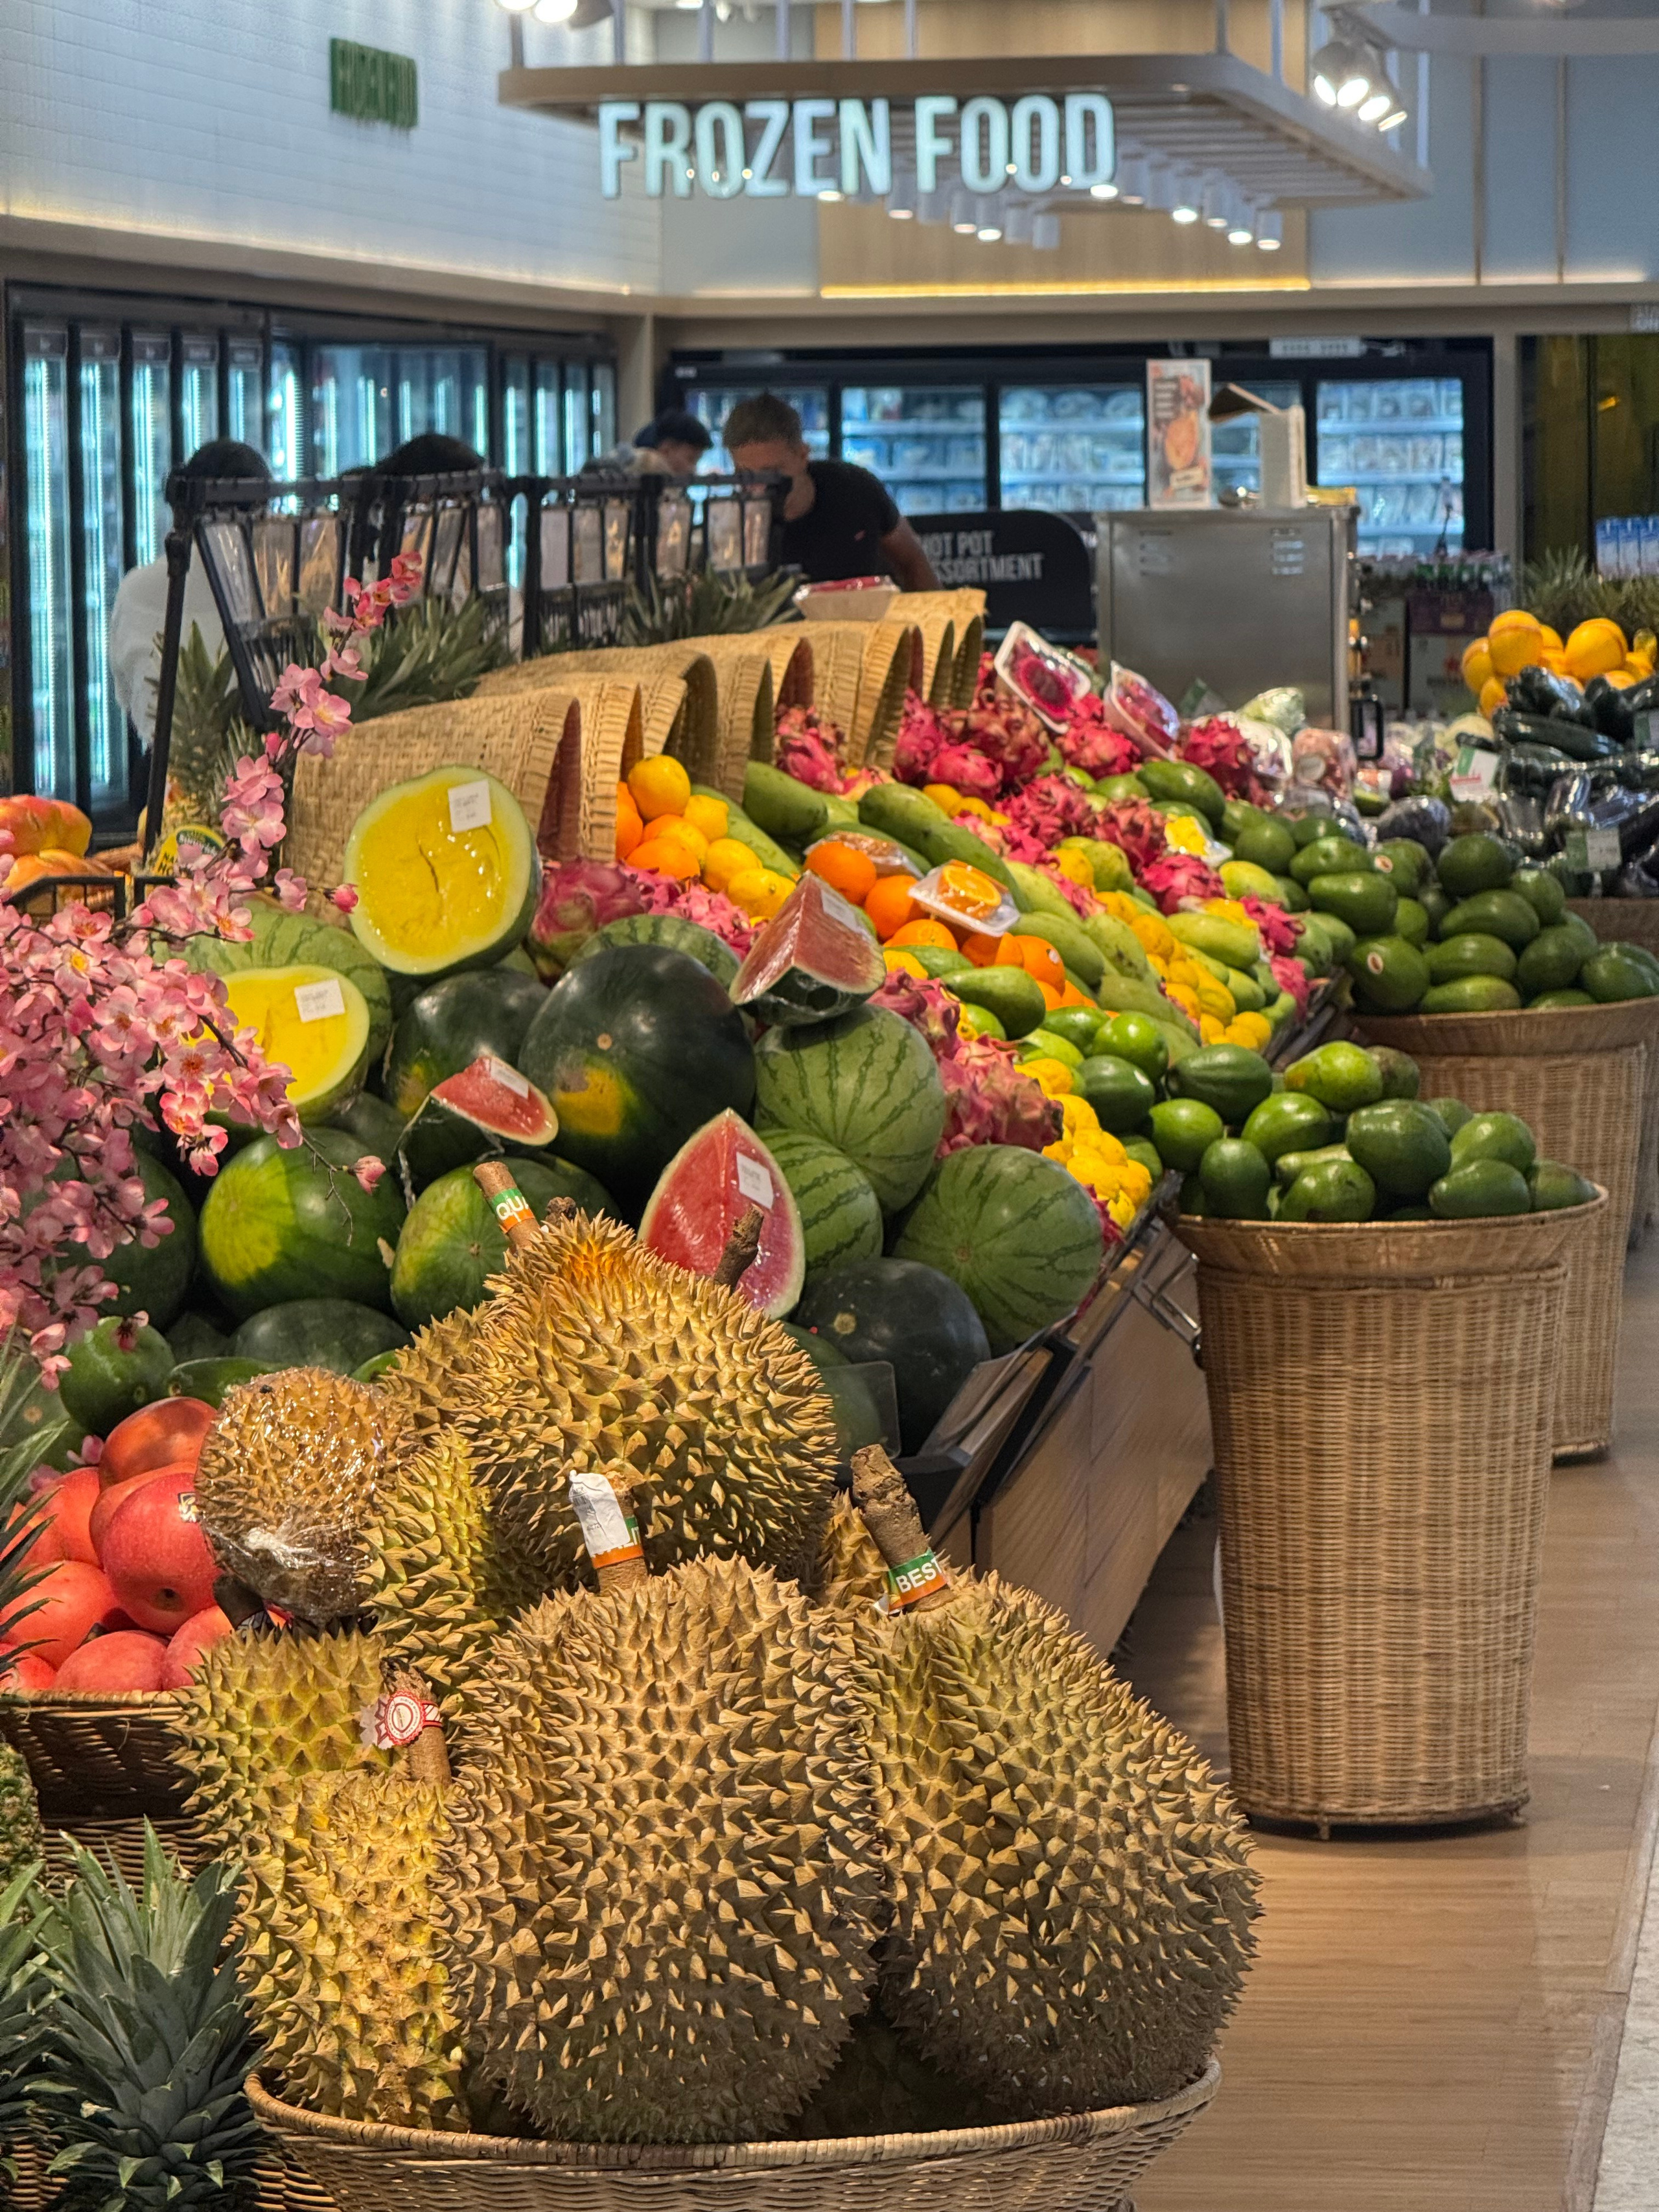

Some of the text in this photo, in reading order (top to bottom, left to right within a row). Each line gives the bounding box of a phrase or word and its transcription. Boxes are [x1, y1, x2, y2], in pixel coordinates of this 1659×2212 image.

[599, 93, 1115, 198] FROZEN FOOD
[957, 530, 993, 555] POT
[896, 1557, 942, 1593] BEST
